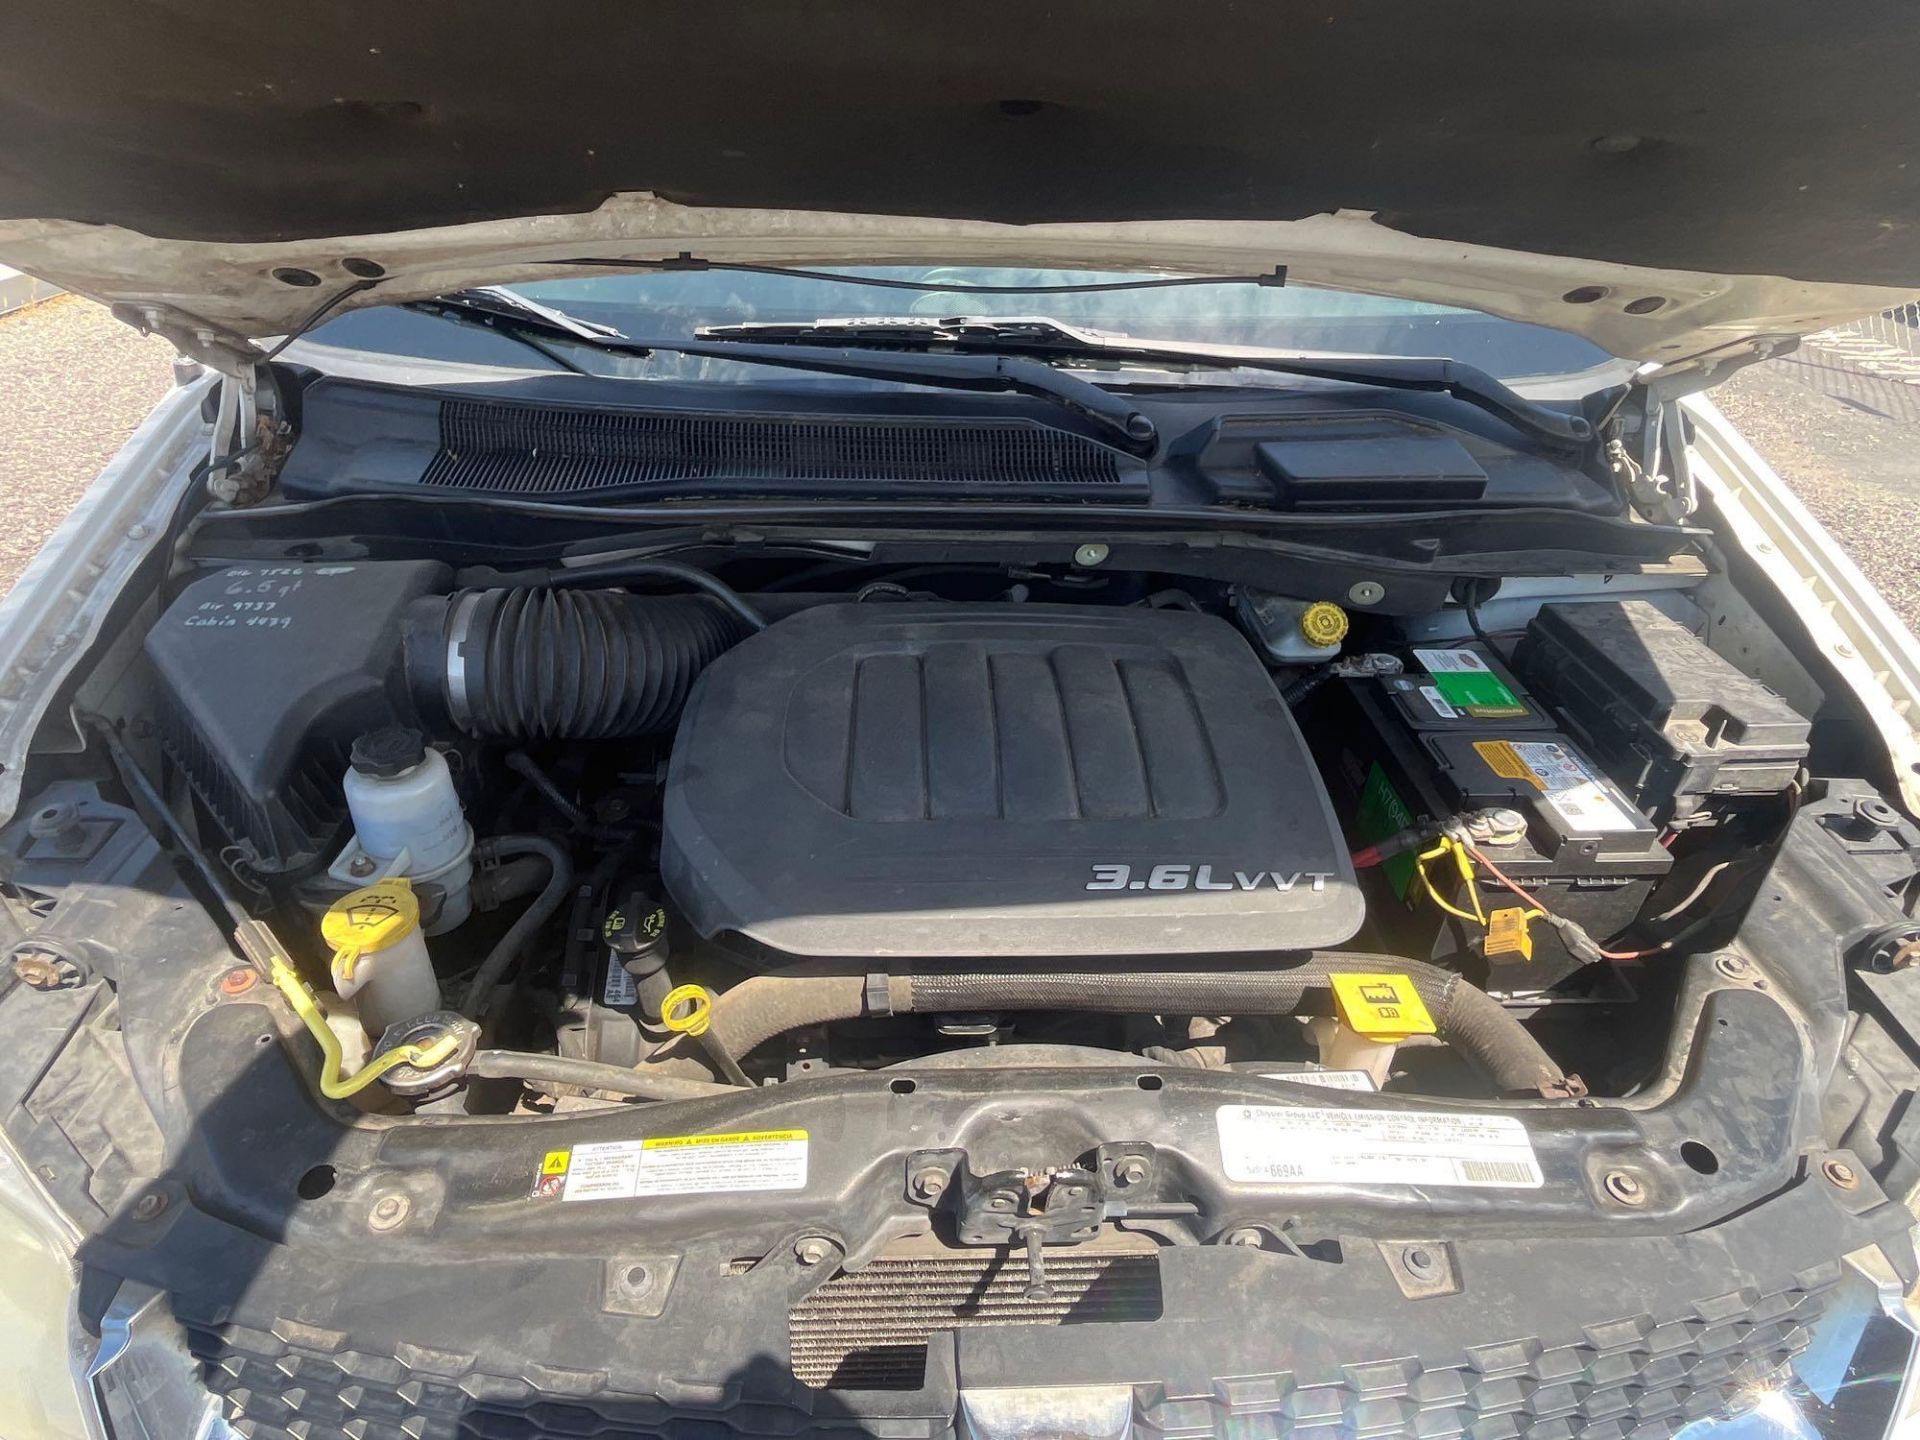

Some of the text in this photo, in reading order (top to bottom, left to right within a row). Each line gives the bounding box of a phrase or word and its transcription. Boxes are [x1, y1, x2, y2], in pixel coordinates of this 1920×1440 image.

[184, 615, 237, 627] Cabin
[1085, 863, 1336, 891] 3.6L VVT
